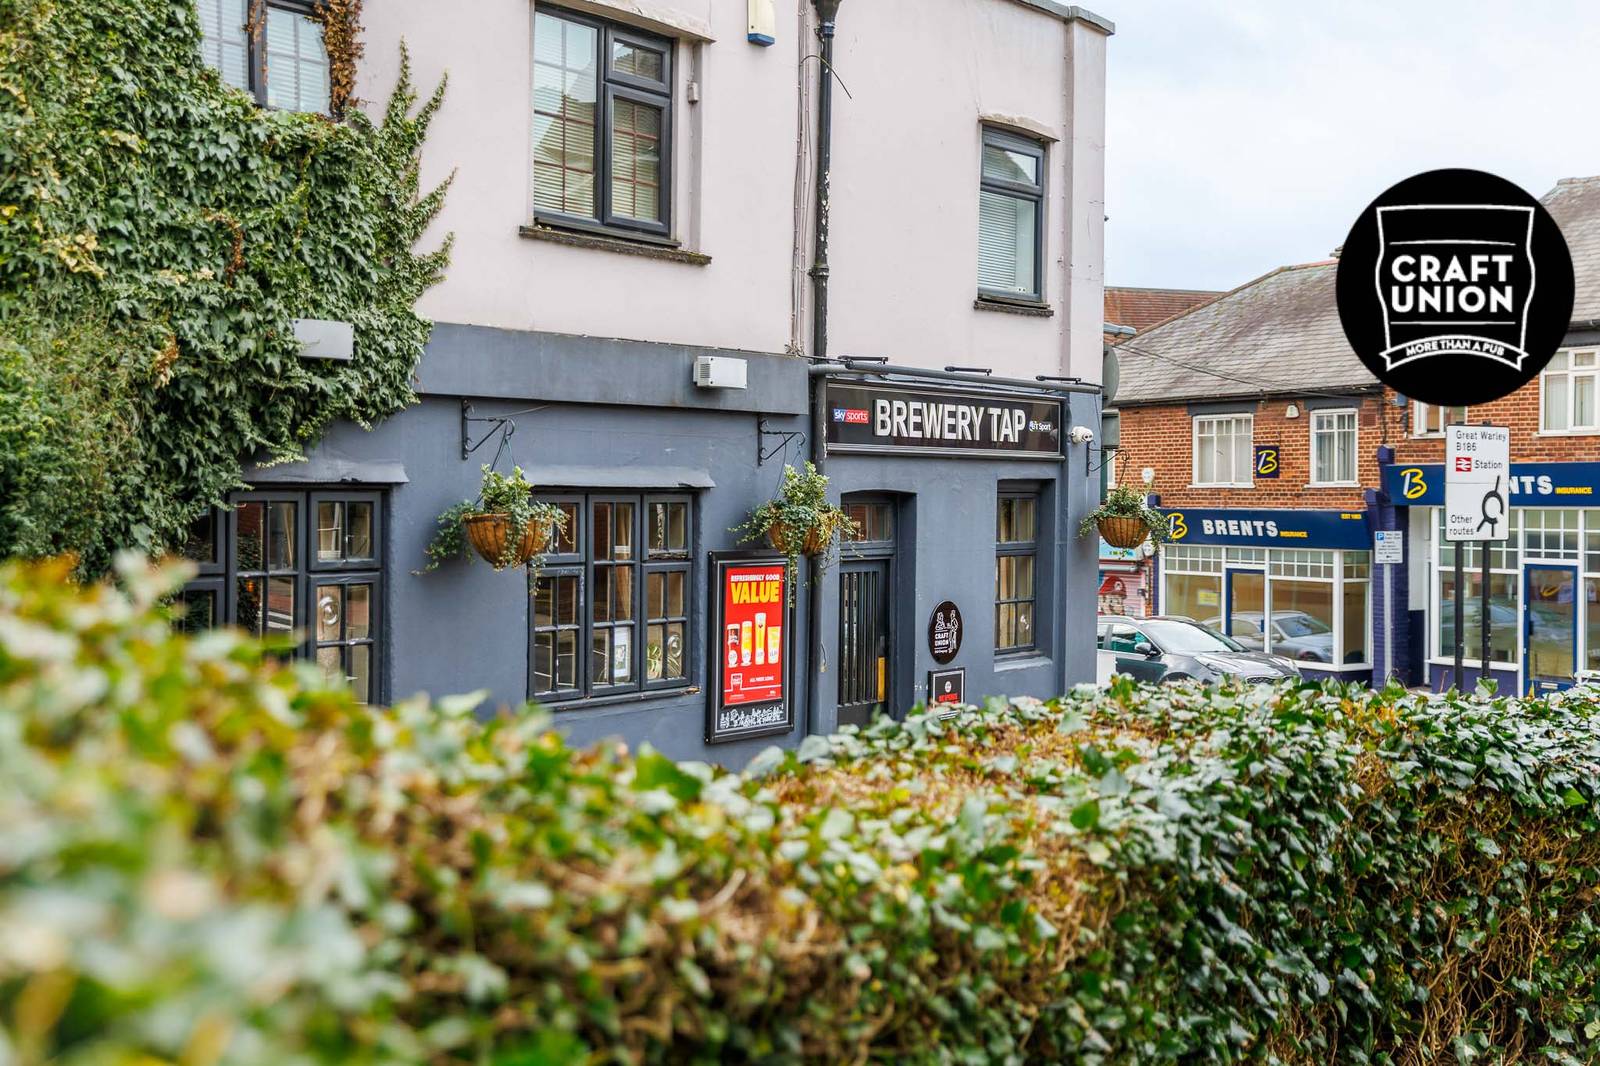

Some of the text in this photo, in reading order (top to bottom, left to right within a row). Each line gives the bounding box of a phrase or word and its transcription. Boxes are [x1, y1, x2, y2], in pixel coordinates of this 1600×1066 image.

[834, 409, 868, 421] sky sports
[873, 399, 1026, 443] BREWERY TAP
[1038, 422, 1051, 431] Sport
[1456, 430, 1507, 442] Great Warley
[1456, 442, 1477, 452] B186
[1474, 460, 1503, 470] Station
[1400, 468, 1428, 499] B
[1451, 514, 1473, 524] Other
[1202, 519, 1279, 538] BRENTS
[1450, 525, 1474, 536] routes
[731, 581, 780, 605] VALUE
